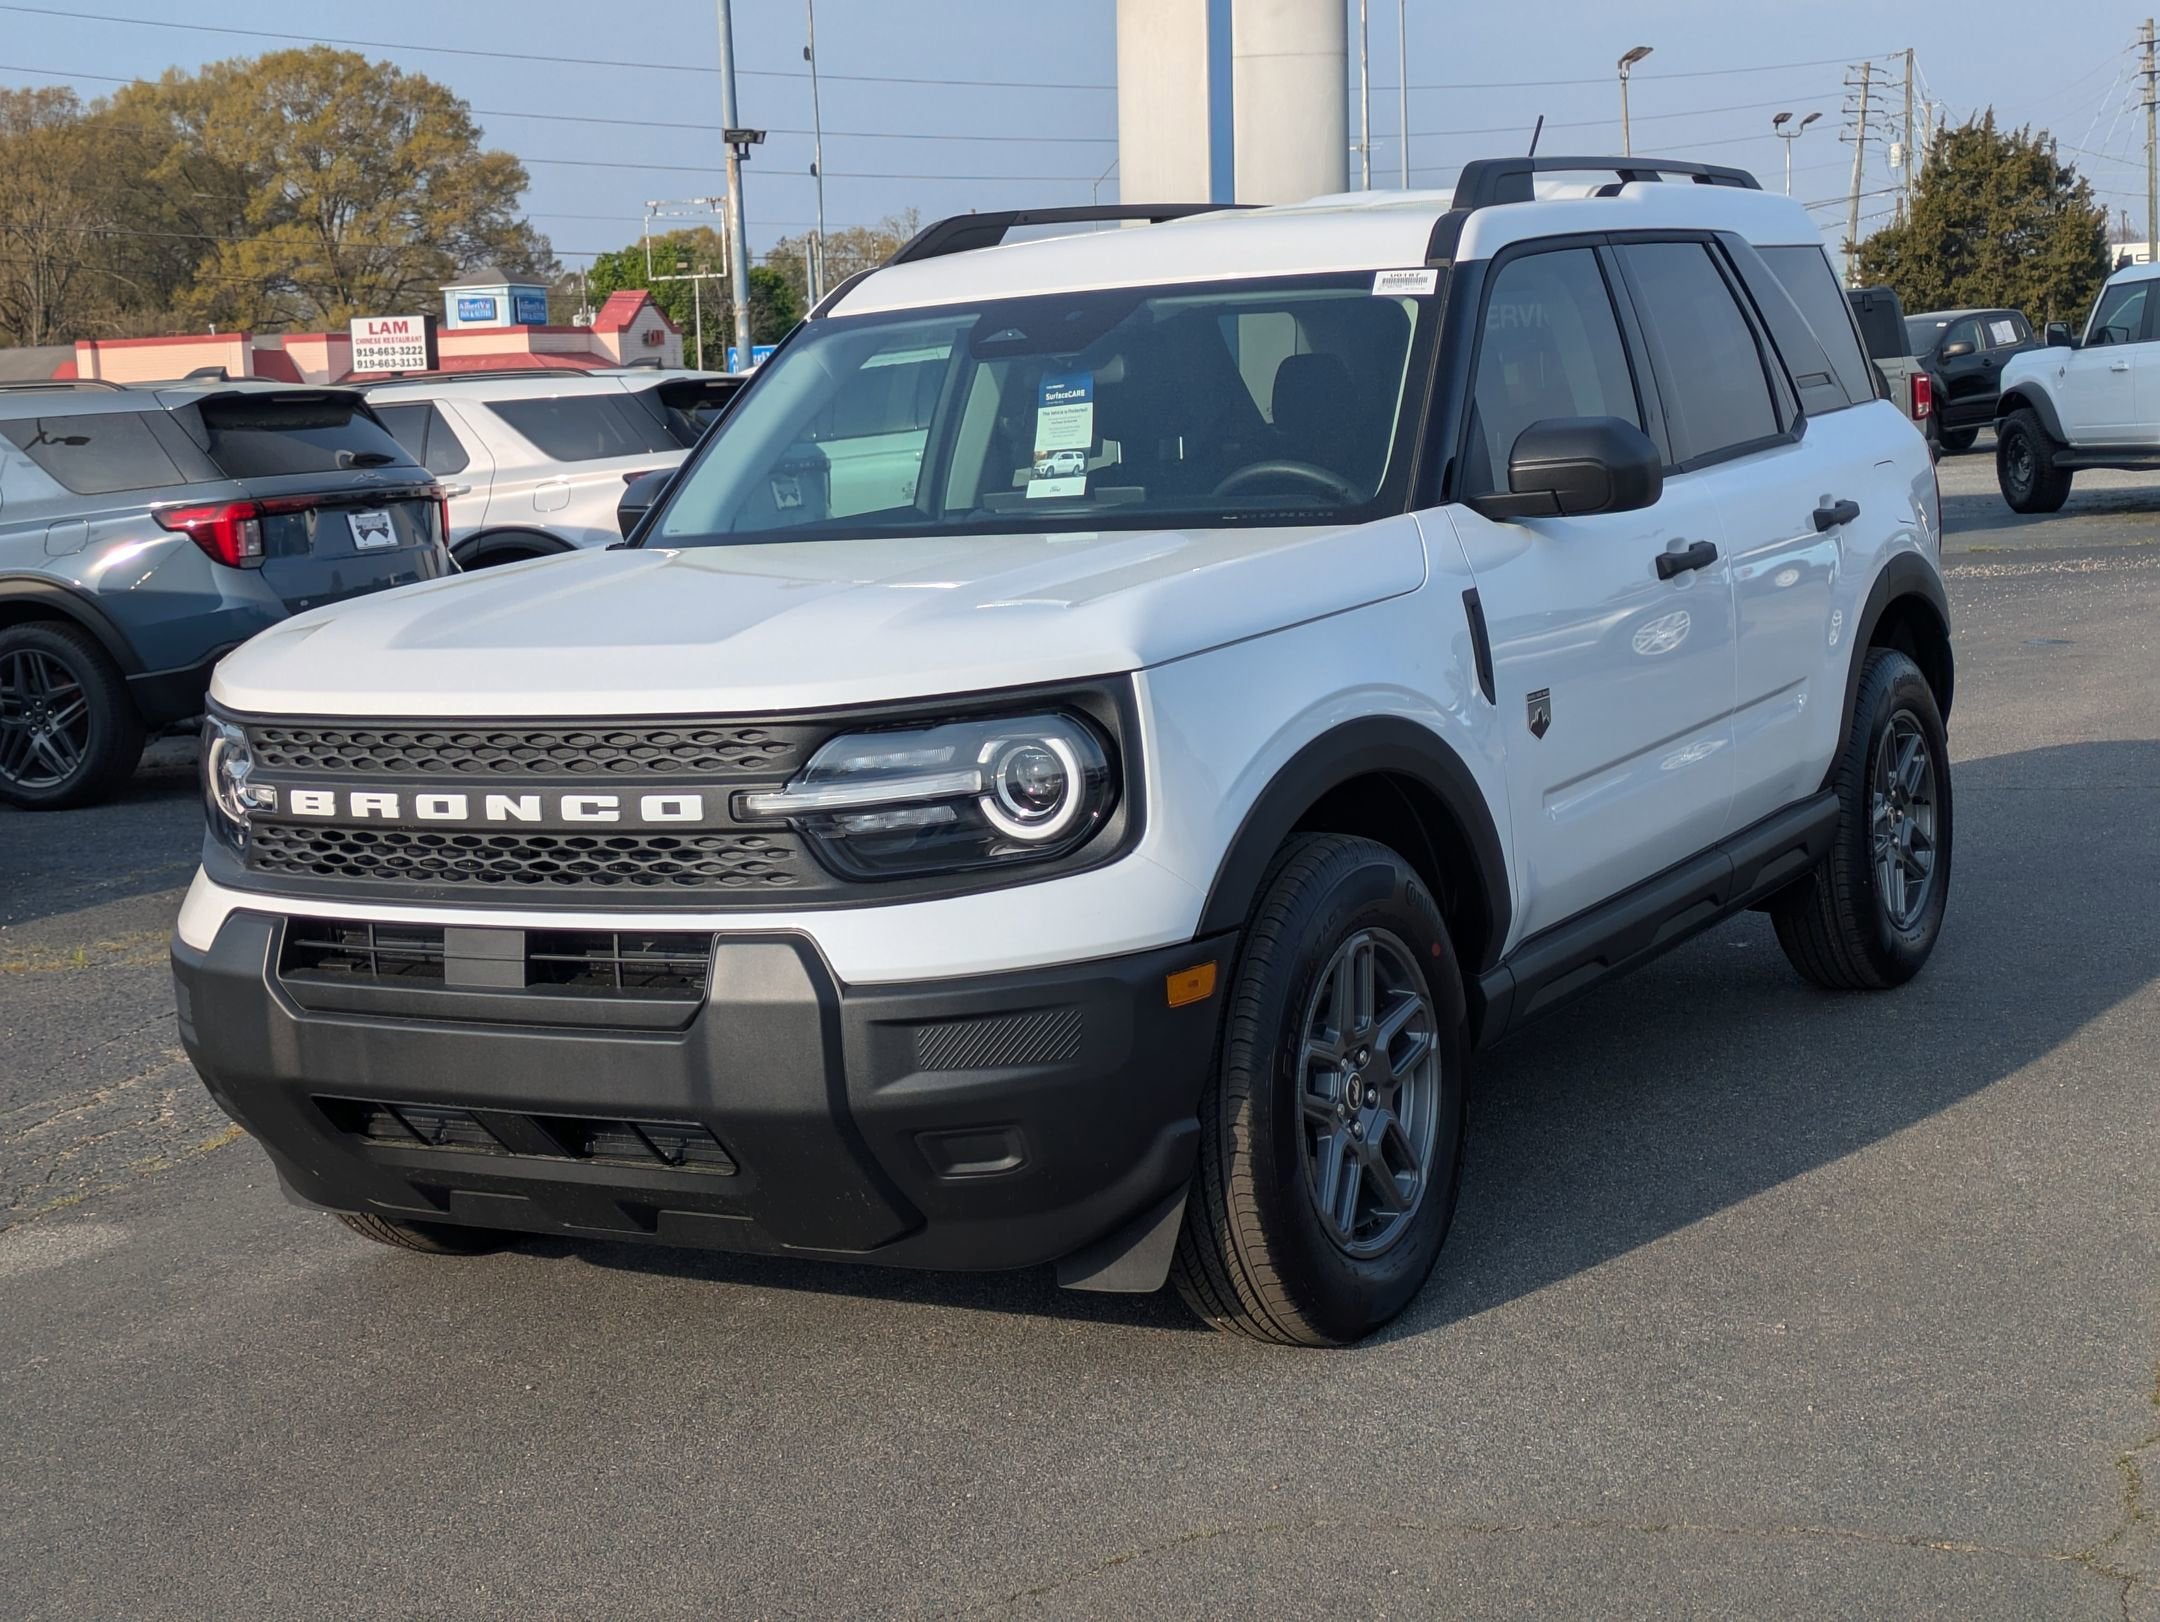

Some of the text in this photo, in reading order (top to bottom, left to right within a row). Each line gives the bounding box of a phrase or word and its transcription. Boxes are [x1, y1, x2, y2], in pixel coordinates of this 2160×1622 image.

[369, 321, 408, 335] LAM
[355, 335, 422, 345] CHINESE RESTAURANT
[356, 345, 424, 358] 919-663-3222
[357, 357, 425, 369] 919-663-3133
[1046, 389, 1085, 401] SurfaceCARE
[290, 788, 703, 822] BRONCO
